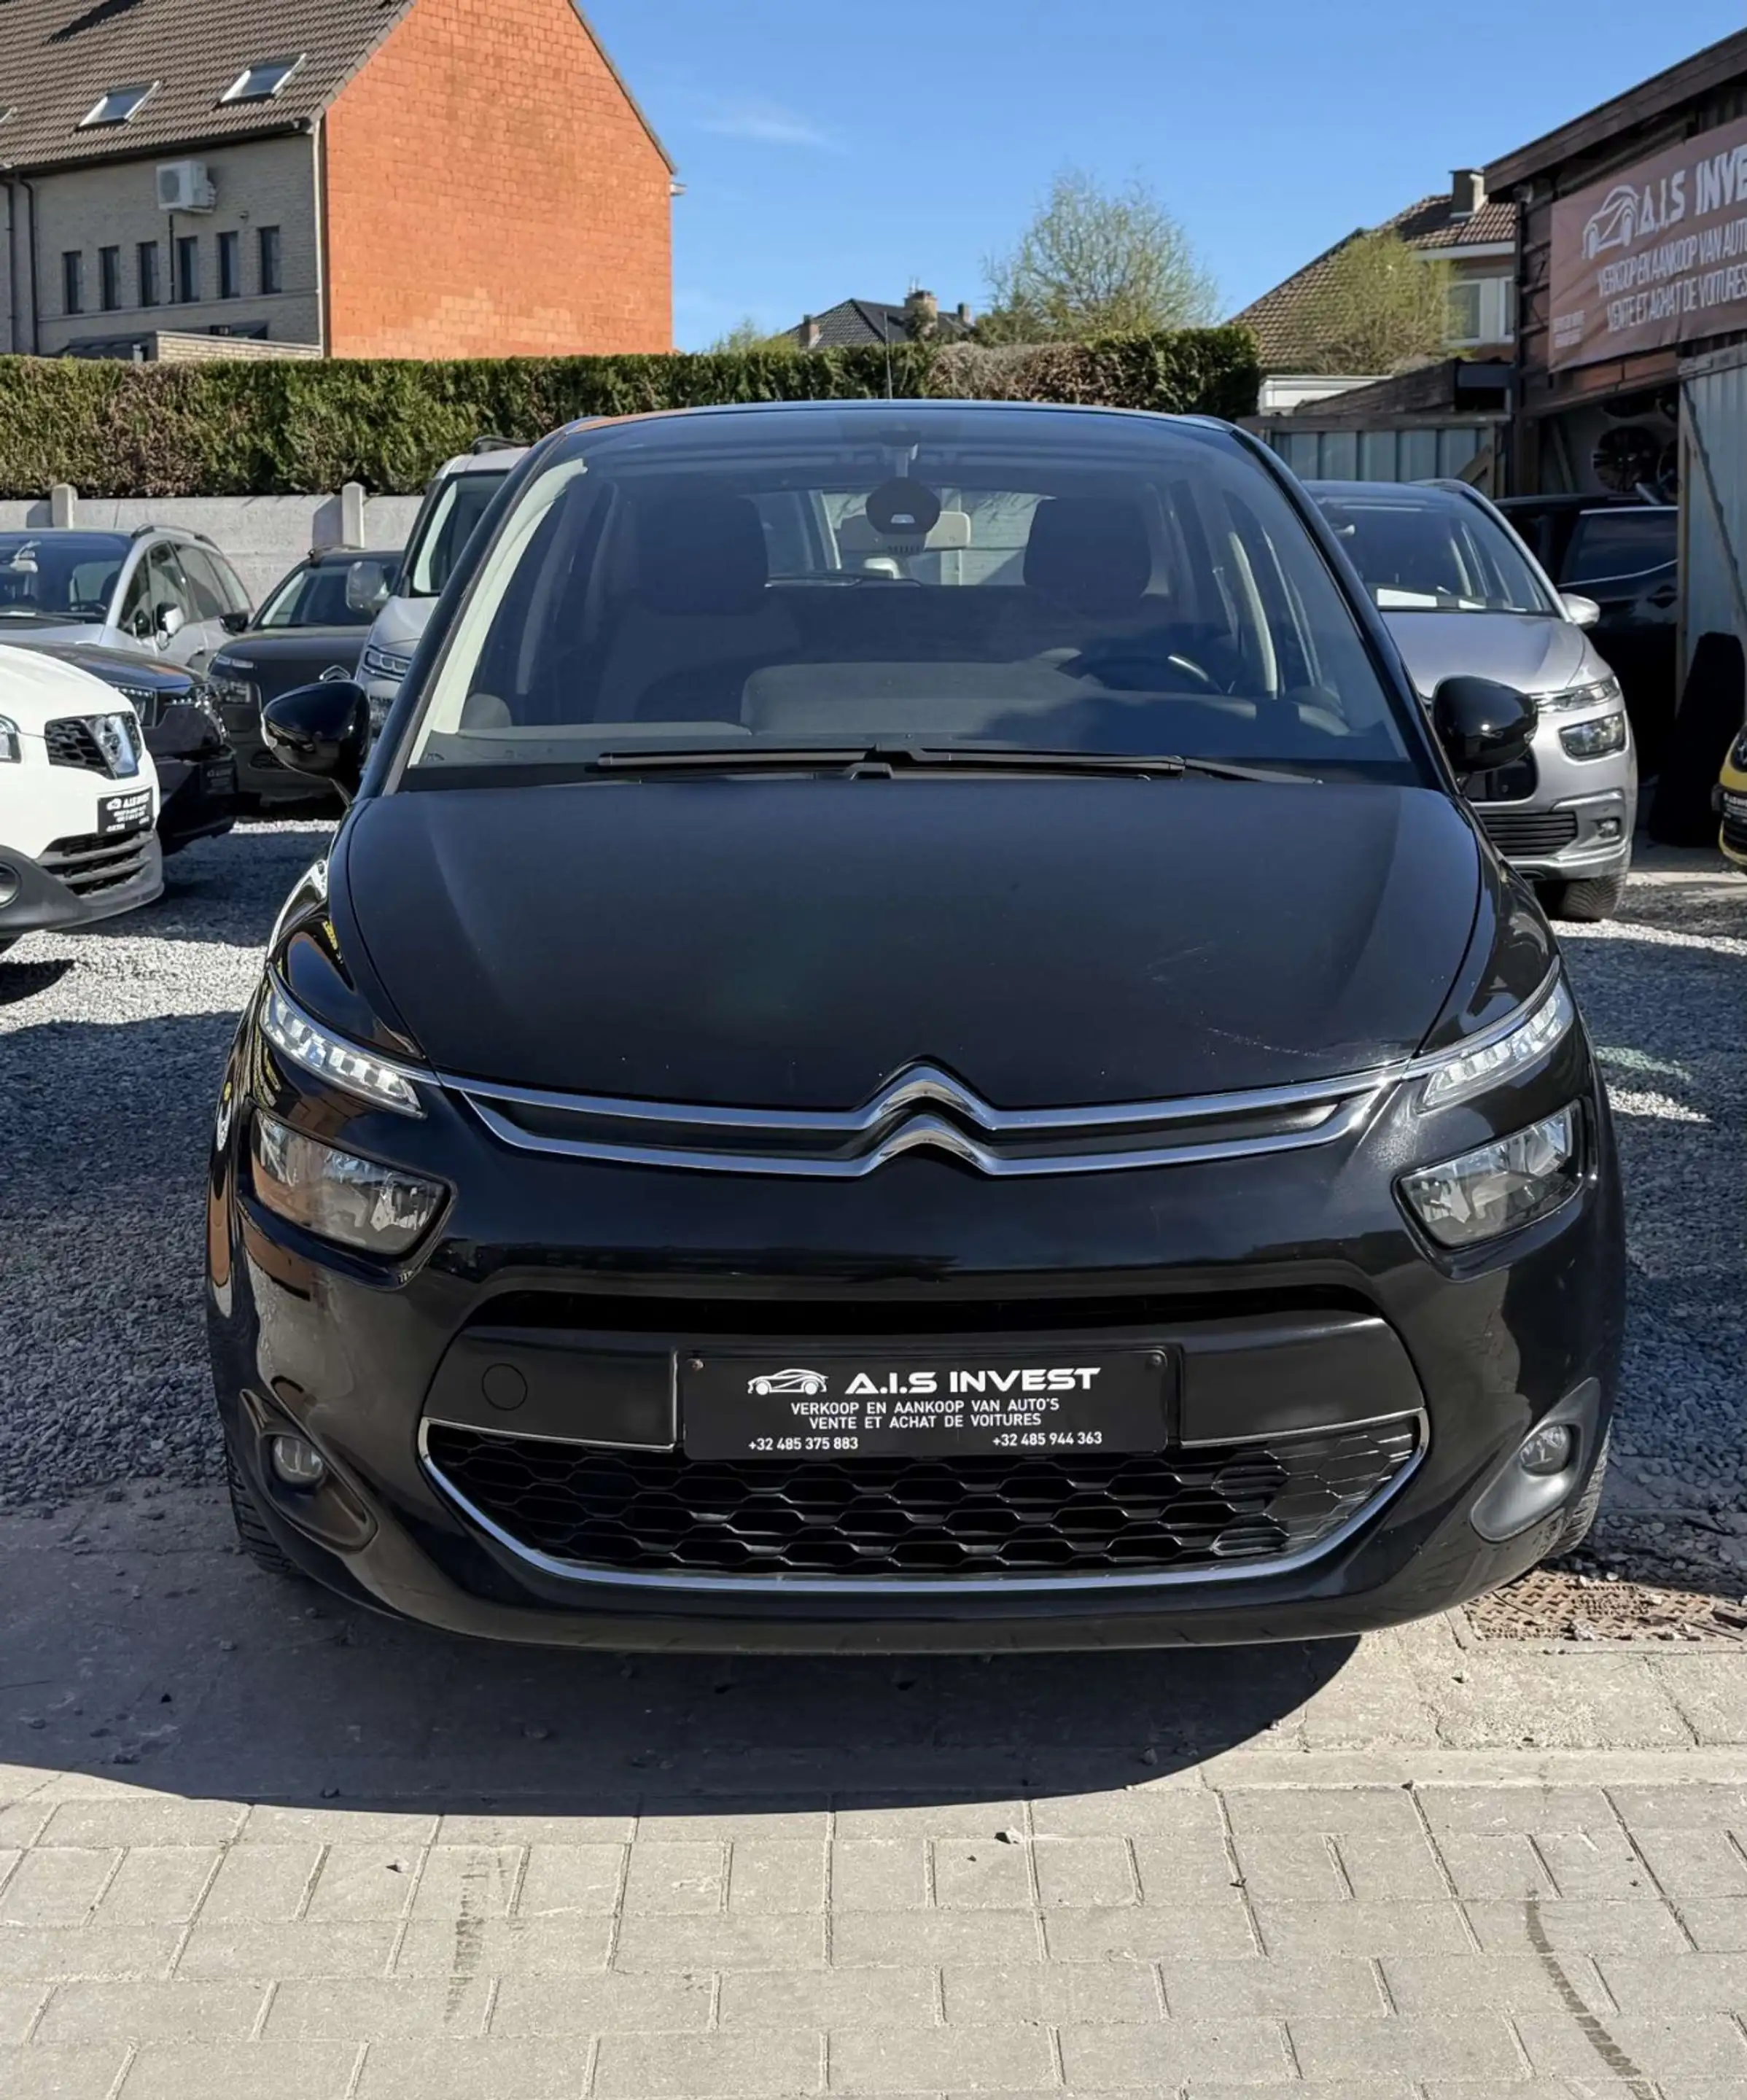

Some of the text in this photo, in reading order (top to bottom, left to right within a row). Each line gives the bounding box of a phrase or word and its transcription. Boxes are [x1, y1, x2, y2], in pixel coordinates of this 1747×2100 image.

[1699, 225, 1722, 265] VAN
[1683, 278, 1698, 312] DE
[844, 1367, 1101, 1394] A.I.S INVEST
[790, 1398, 1059, 1415] VERKOOP EN AANKOOP VAN AUTO'S
[809, 1412, 1042, 1430] VENTE ET ACHAT DE VOITURES
[748, 1436, 859, 1451] +32 485 375 883
[992, 1431, 1102, 1447] +32 485 944 363
